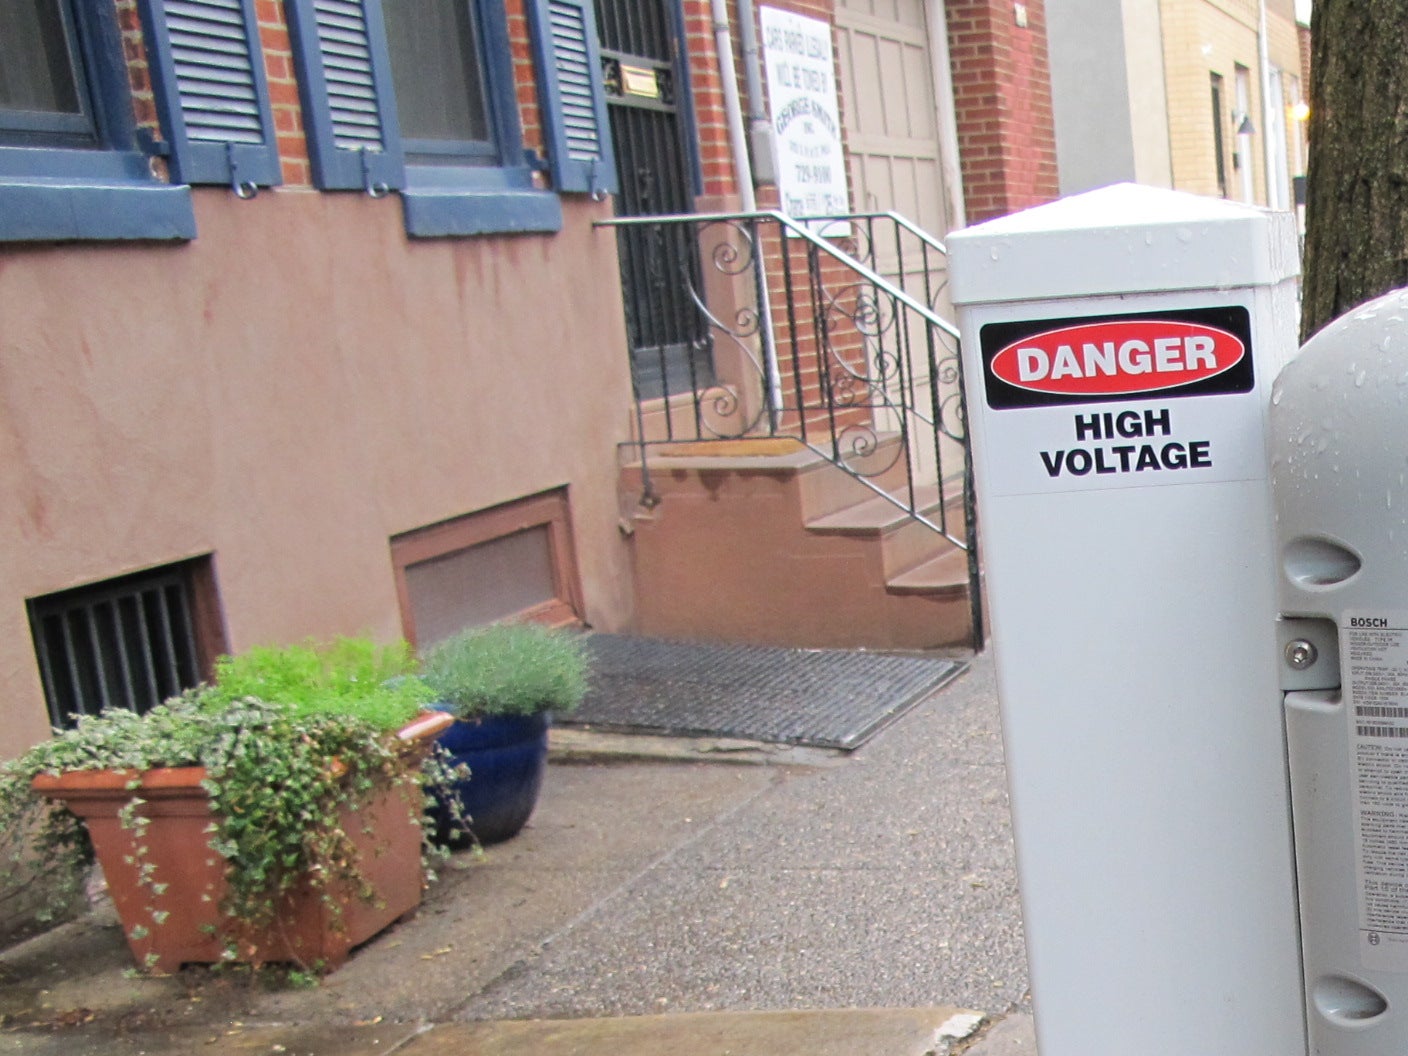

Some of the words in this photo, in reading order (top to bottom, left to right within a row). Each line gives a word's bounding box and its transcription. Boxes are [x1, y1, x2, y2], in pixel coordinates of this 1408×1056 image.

[775, 96, 810, 134] GEORGE
[1016, 336, 1217, 382] DANGER
[1075, 409, 1171, 441] HIGH
[1039, 440, 1212, 478] VOLTAGE
[1350, 618, 1388, 627] BOSCH
